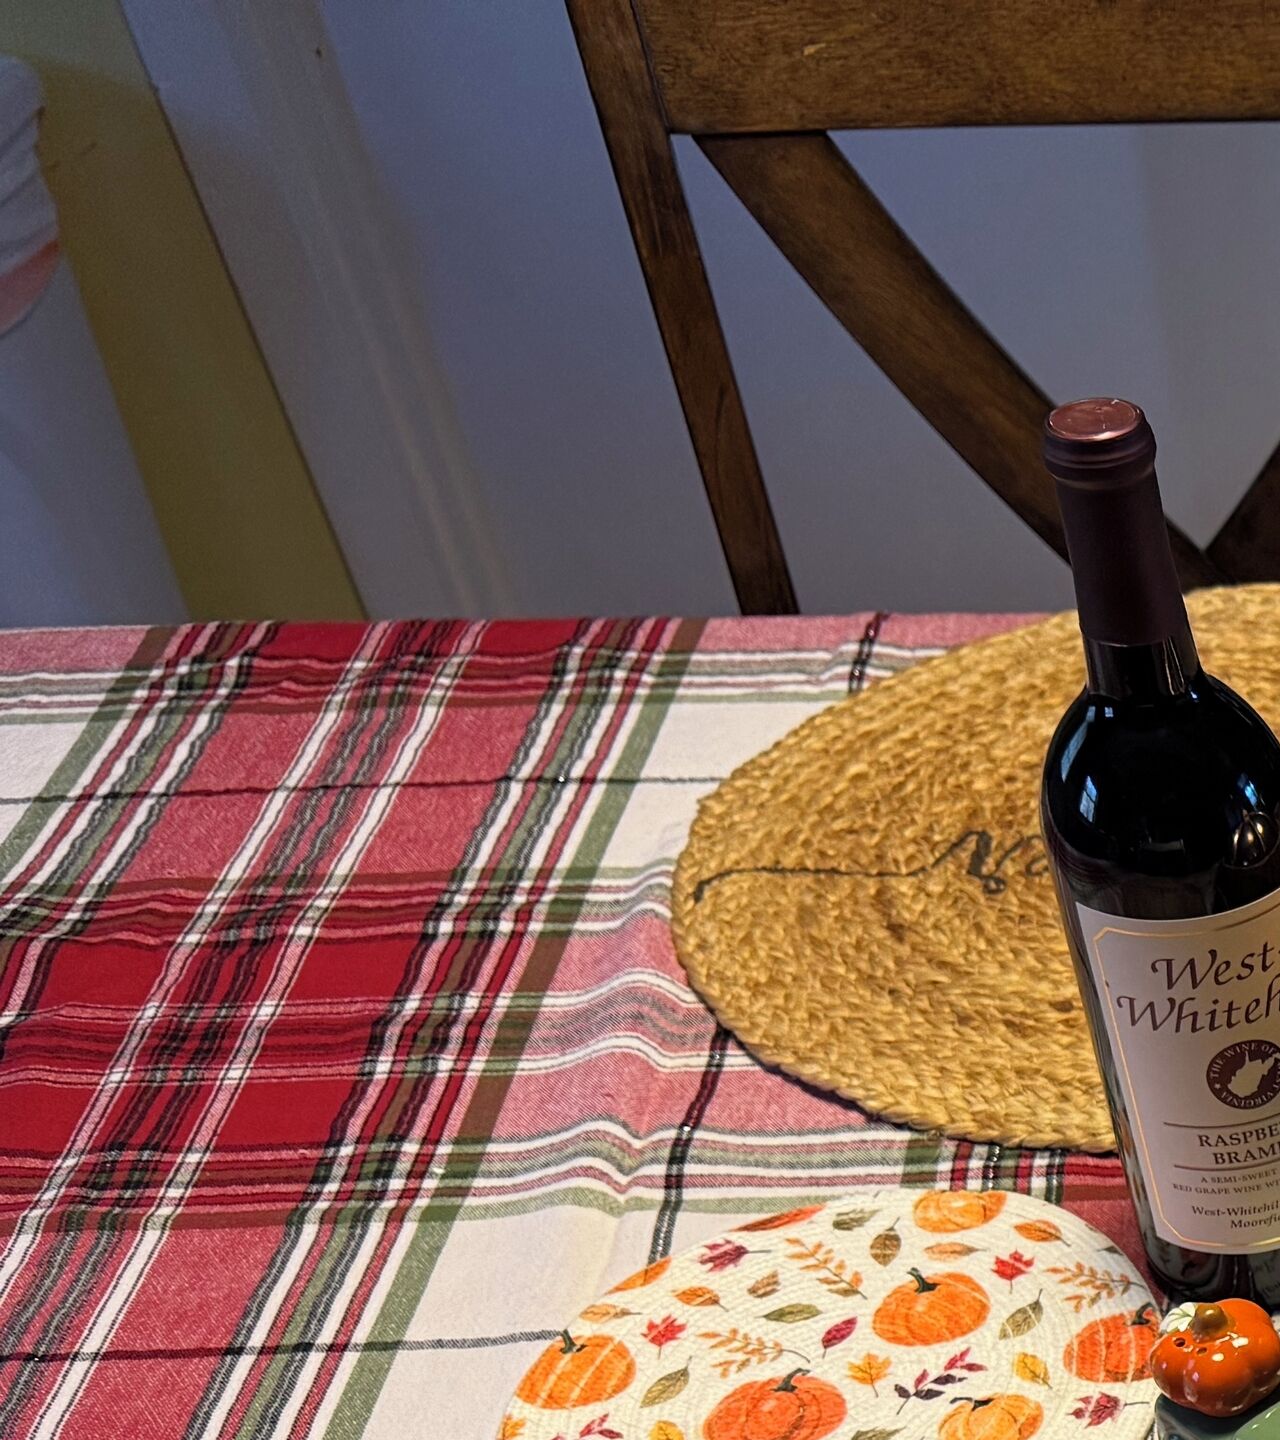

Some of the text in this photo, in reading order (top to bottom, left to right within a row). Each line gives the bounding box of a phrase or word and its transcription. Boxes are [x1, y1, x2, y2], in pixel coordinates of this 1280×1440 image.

[1201, 1176, 1208, 1184] A
[1211, 1169, 1277, 1185] SEMI-SWEET
[1172, 1183, 1193, 1191] RED
[1194, 1186, 1230, 1195] GRAPE
[1233, 1183, 1262, 1194] WINE
